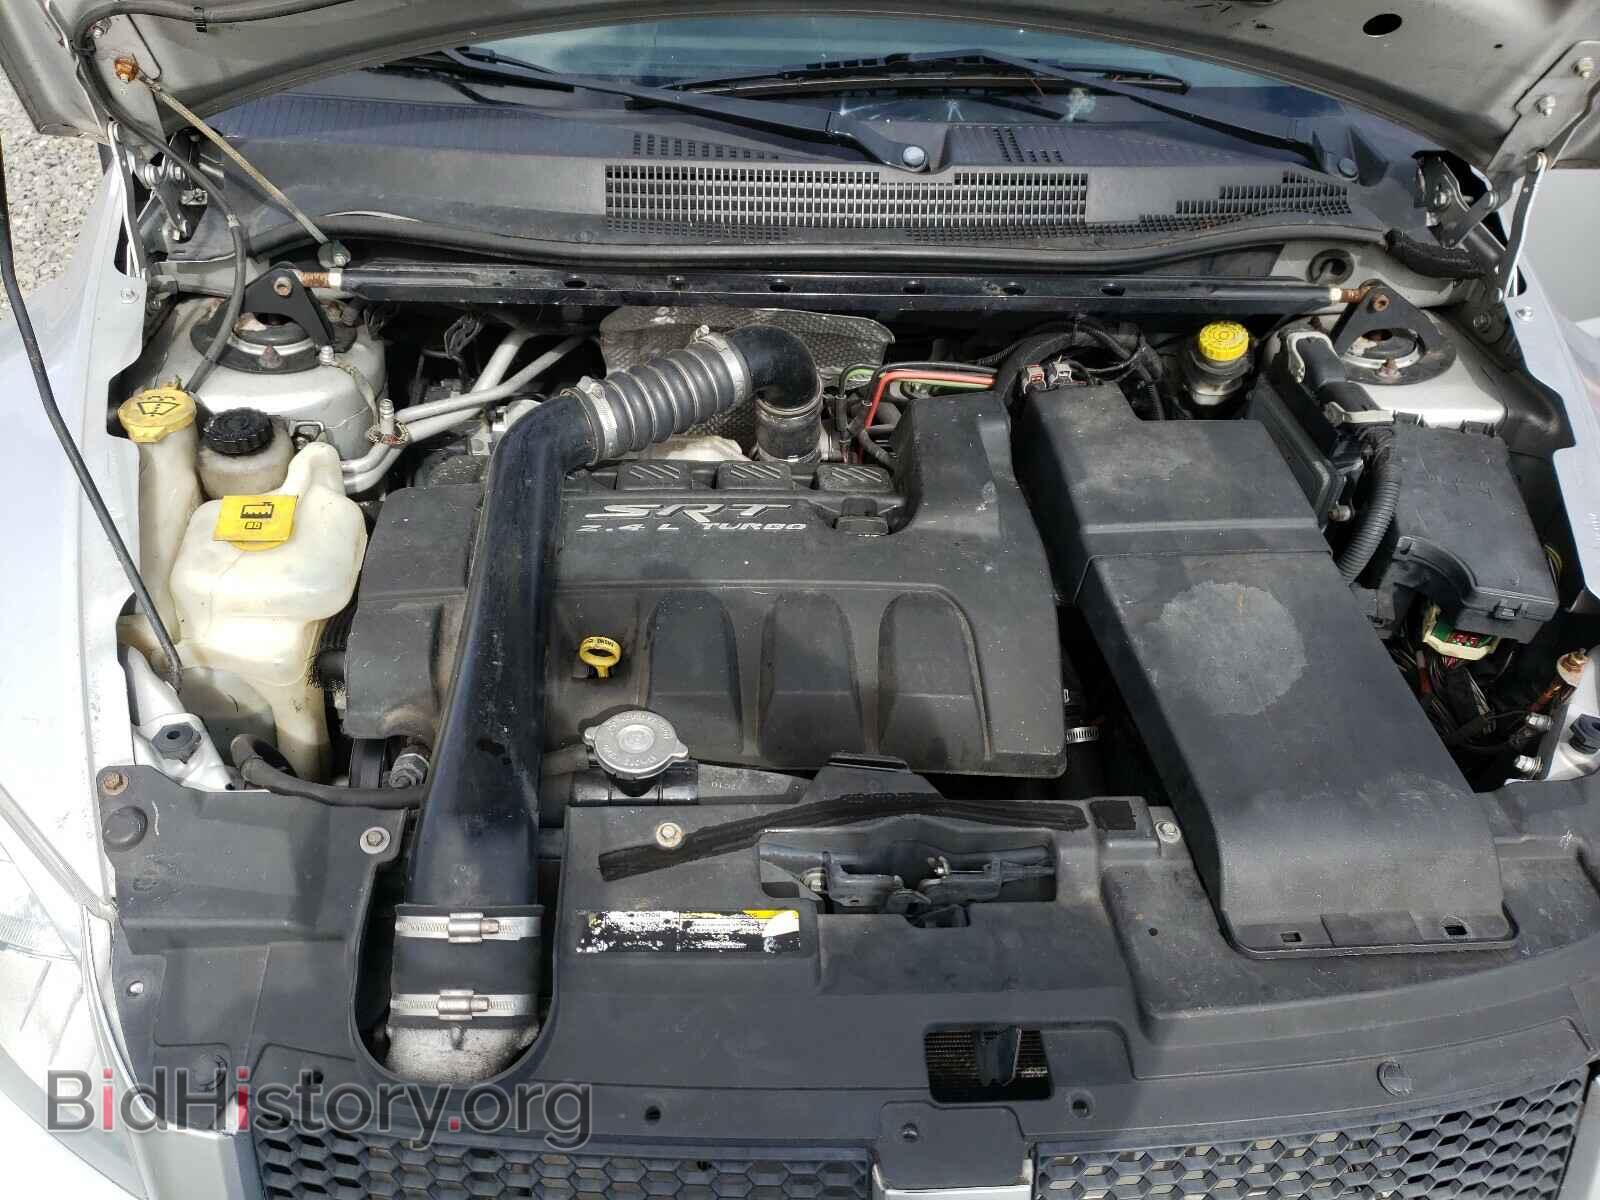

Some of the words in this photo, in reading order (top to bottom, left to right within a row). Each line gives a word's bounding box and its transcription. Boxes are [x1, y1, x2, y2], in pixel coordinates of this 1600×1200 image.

[585, 503, 792, 523] SRT
[575, 523, 645, 532] 2.4
[656, 523, 680, 531] L
[703, 522, 807, 531] TURBO
